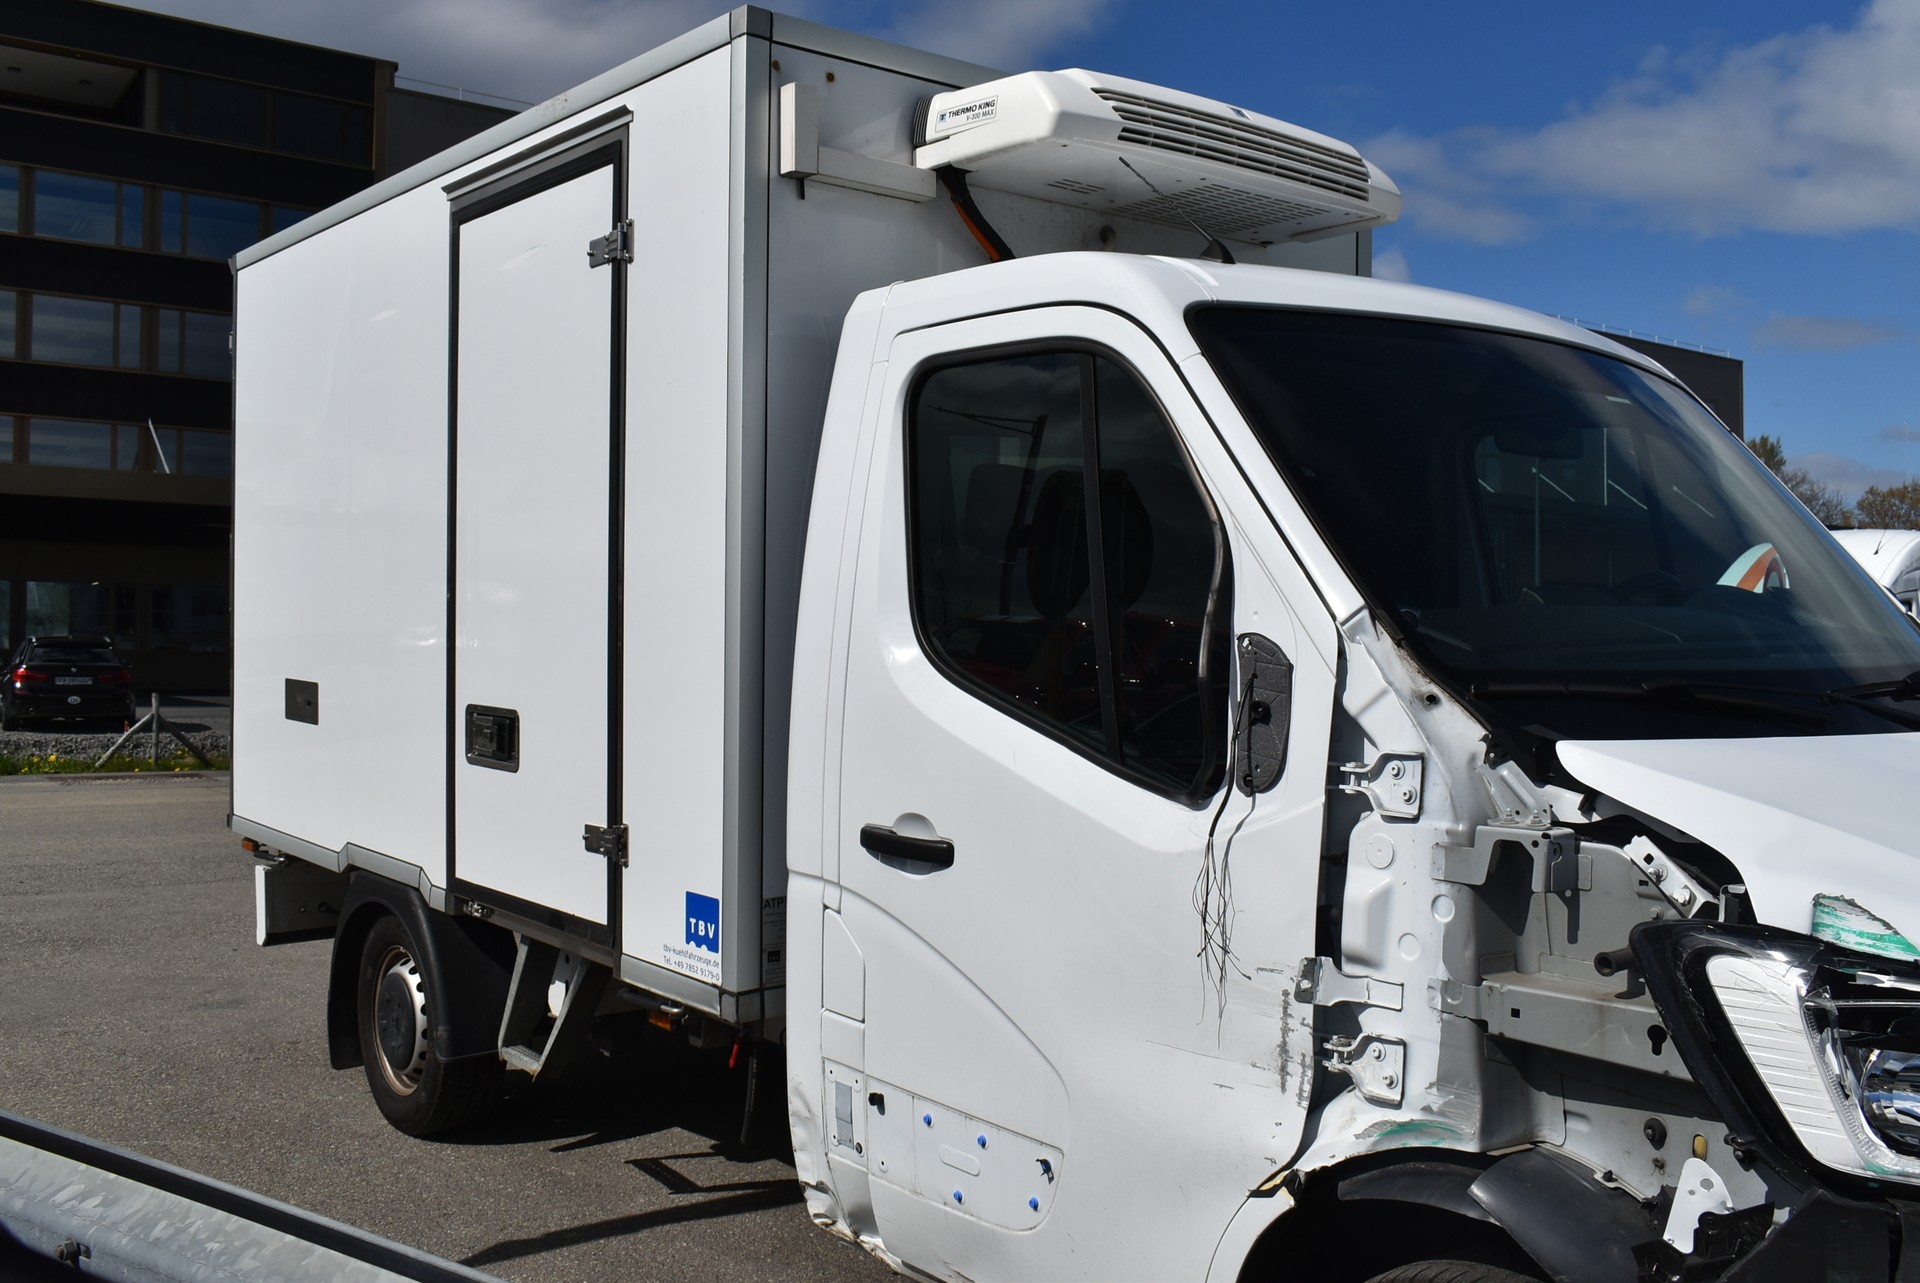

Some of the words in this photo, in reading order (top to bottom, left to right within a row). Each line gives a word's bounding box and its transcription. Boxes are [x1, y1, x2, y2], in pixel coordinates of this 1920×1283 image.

[948, 104, 977, 119] THERMO
[978, 99, 996, 111] KING
[966, 112, 981, 121] V-300
[981, 109, 994, 118] MAX
[763, 897, 784, 909] ATP
[689, 917, 716, 939] TBV
[663, 944, 720, 968] tbv-kuehlfahrzeuge.de
[663, 955, 673, 965] Tel.
[673, 960, 684, 970] +49
[700, 967, 720, 981] 9179-0
